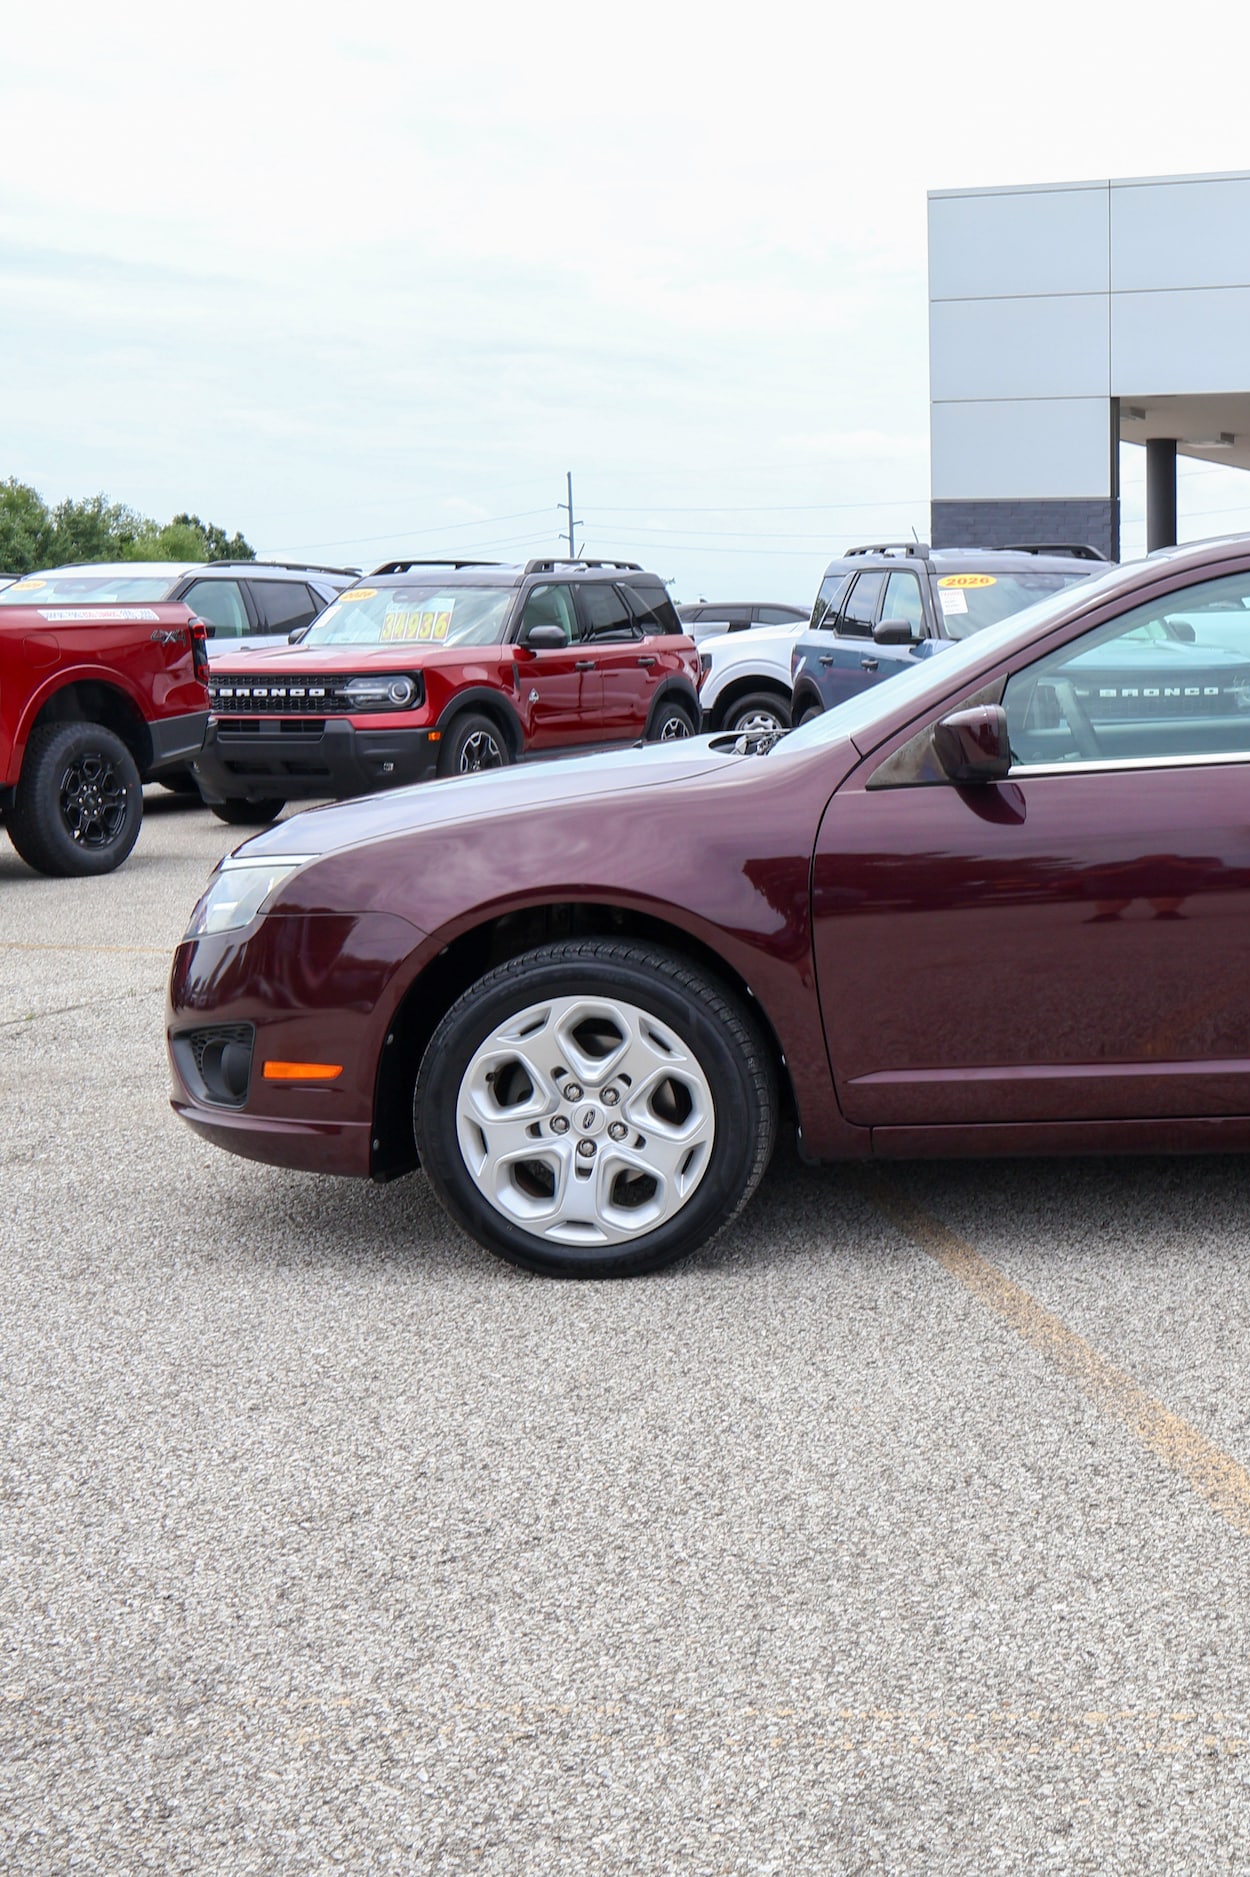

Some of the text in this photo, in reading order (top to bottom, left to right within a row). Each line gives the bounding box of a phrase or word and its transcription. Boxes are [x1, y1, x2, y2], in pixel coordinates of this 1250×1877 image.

[946, 577, 990, 587] 2026
[382, 612, 450, 639] 34936
[219, 687, 325, 698] BRONCO
[1100, 687, 1219, 698] BRONCO
